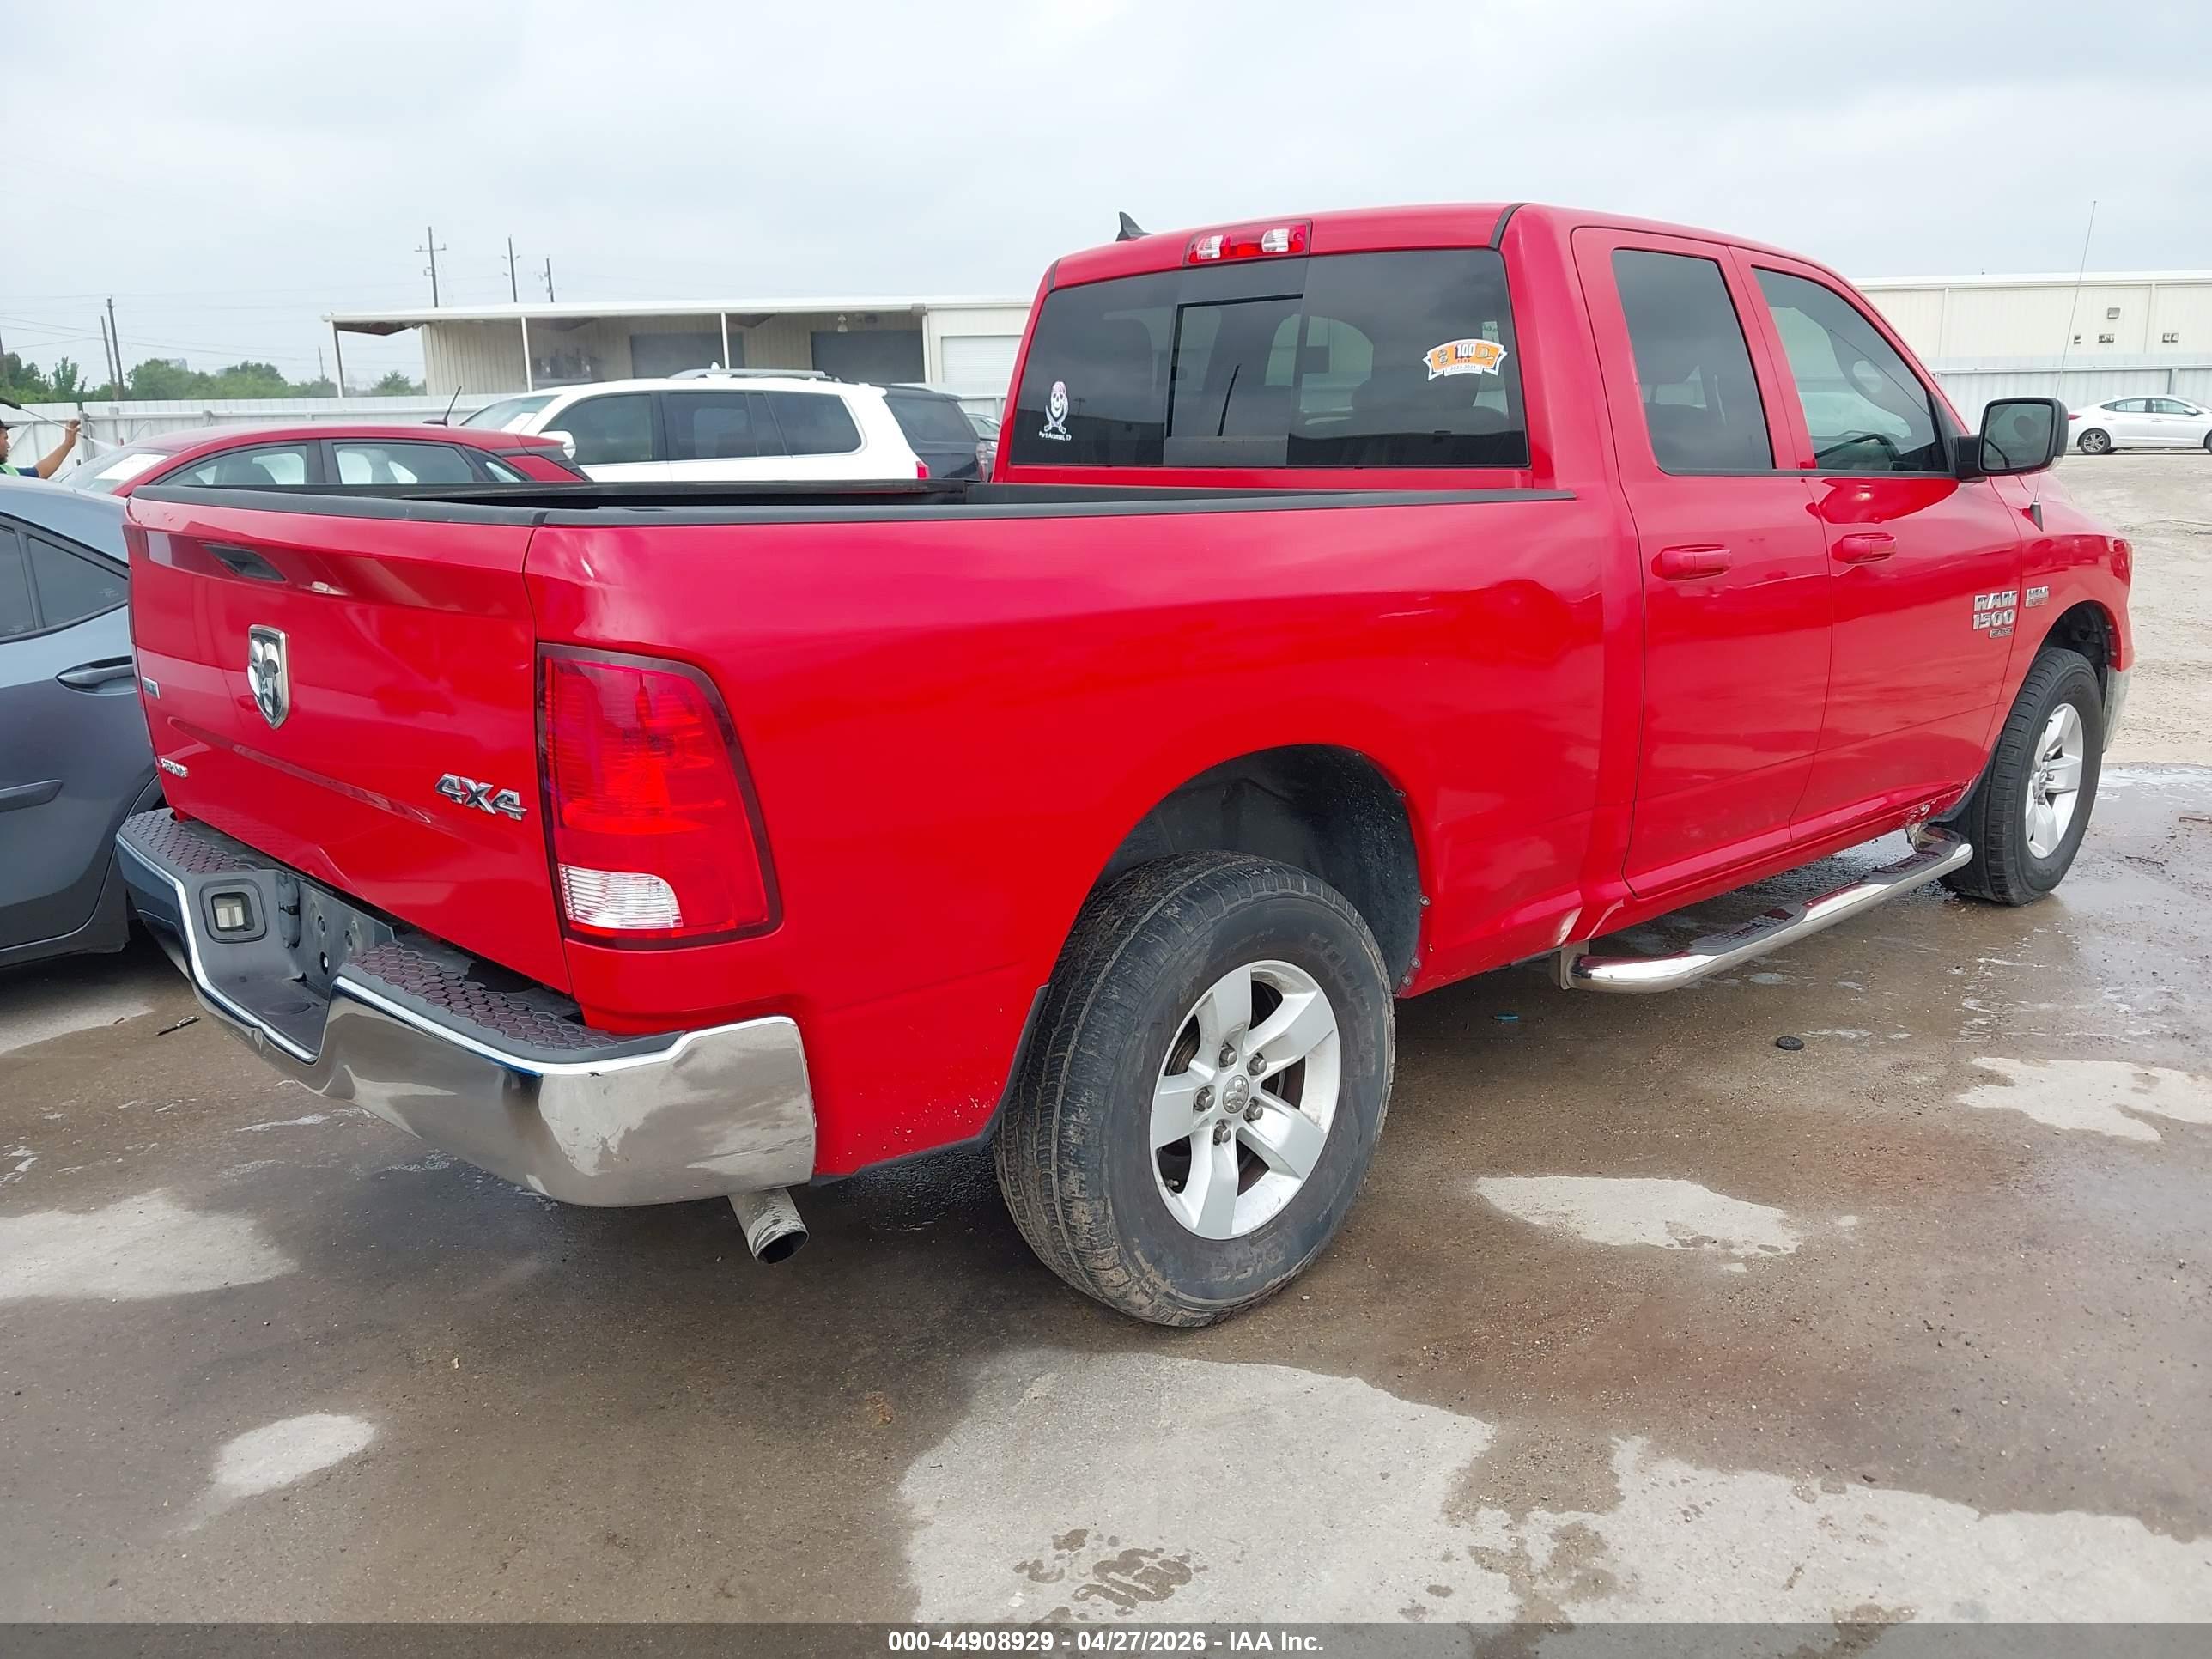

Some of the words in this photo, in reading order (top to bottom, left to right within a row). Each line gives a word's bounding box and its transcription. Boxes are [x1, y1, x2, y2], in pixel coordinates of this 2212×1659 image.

[1455, 343, 1476, 358] 100
[1973, 590, 2018, 612] RAM
[1972, 609, 2015, 630] 1500
